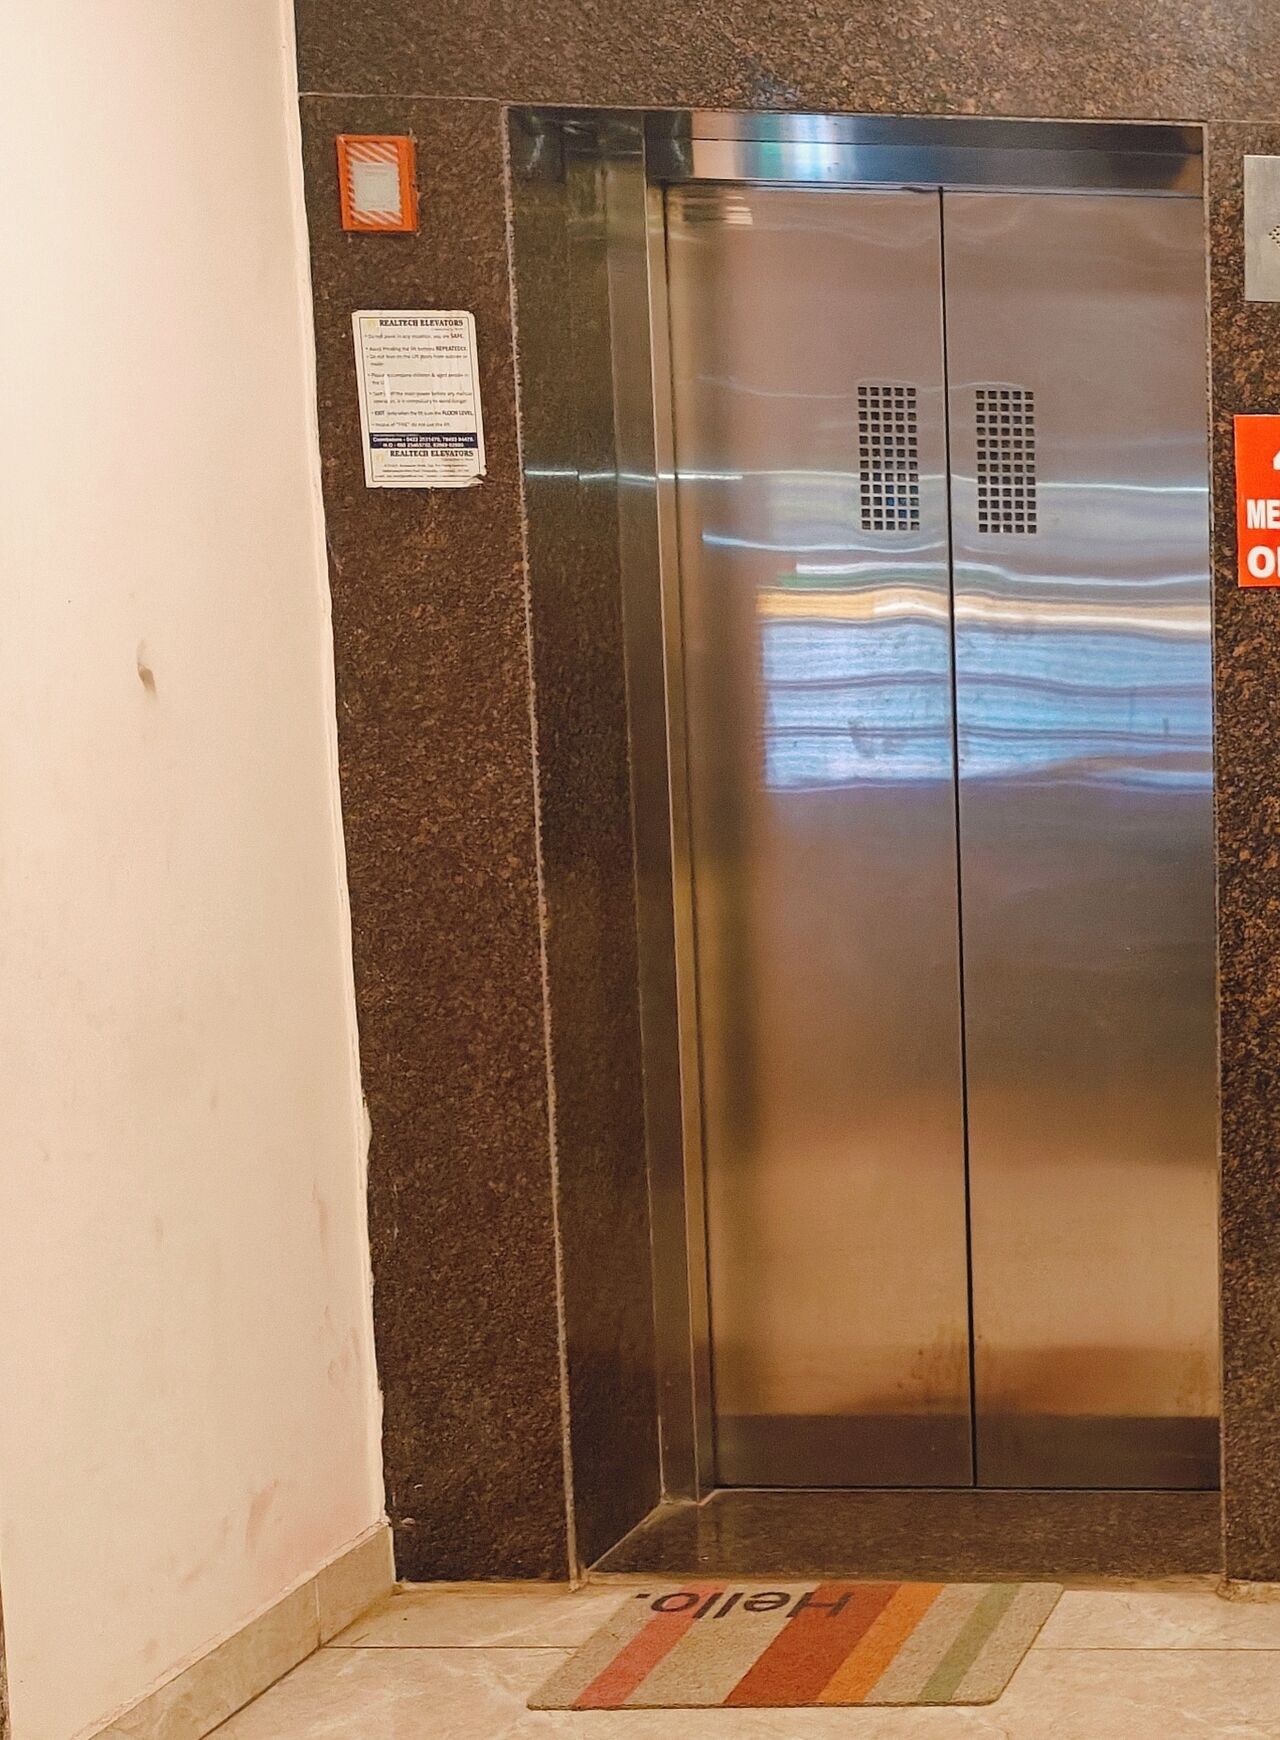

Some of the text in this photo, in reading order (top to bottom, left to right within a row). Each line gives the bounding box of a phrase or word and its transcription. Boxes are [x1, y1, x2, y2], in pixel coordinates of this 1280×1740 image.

[379, 319, 464, 327] REALTECH ELEVATORS
[635, 1591, 855, 1619] Hello.
